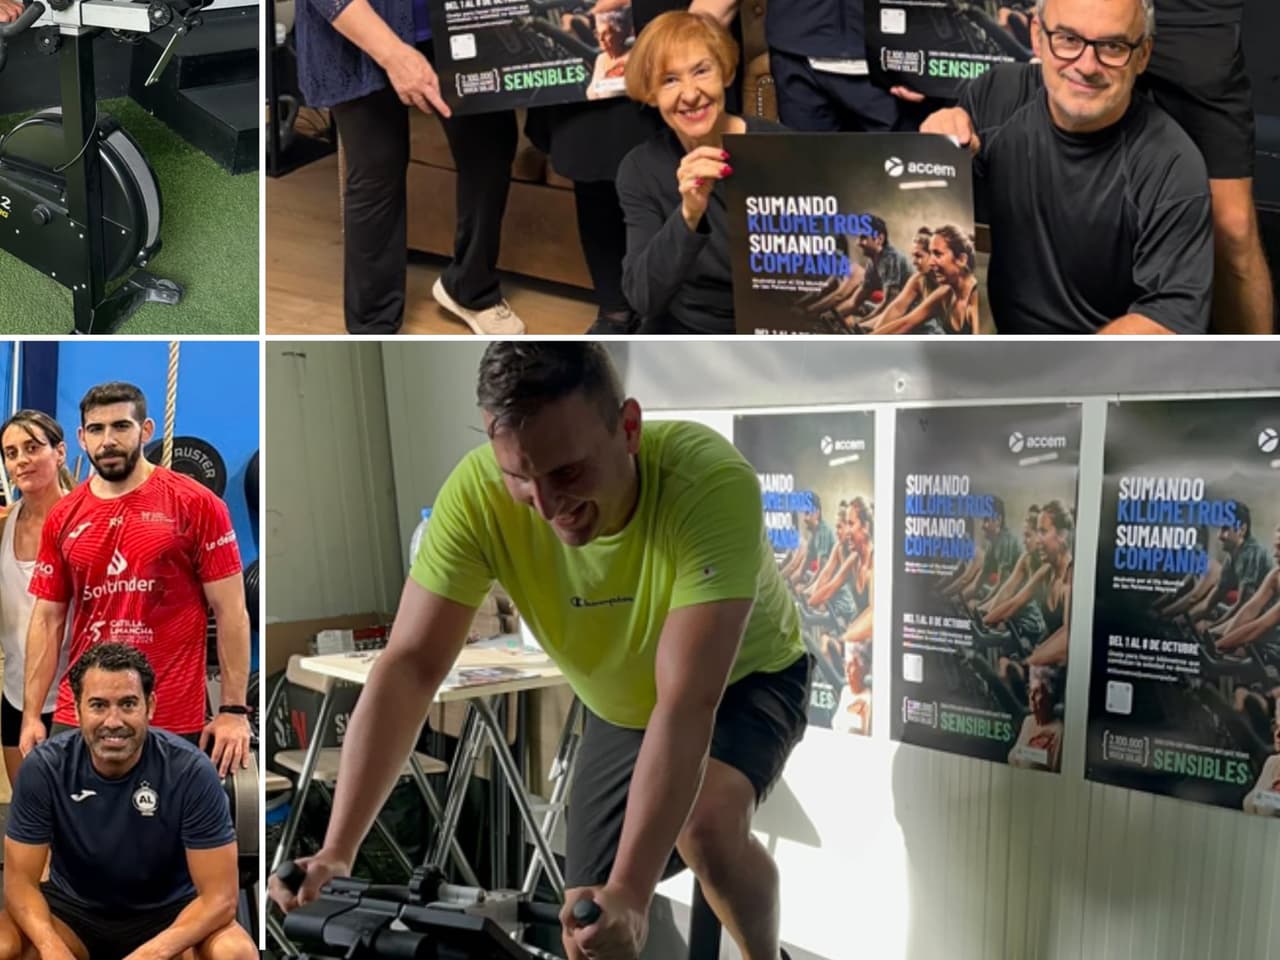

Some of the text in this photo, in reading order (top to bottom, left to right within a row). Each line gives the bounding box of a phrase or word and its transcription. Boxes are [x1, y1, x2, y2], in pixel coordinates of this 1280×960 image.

[503, 65, 585, 91] SENSIBLES
[908, 161, 956, 177] accem
[1, 196, 11, 209] 2
[746, 196, 837, 215] SUMANDO
[749, 235, 836, 255] SUMANDO
[905, 474, 970, 496] SUMANDO
[1118, 476, 1205, 503] SUMANDO
[905, 517, 966, 538] SUMANDO
[1115, 525, 1197, 550] SUMANDO
[940, 711, 1012, 741] SENSIBLES
[1153, 748, 1249, 786] SENSIBLES
